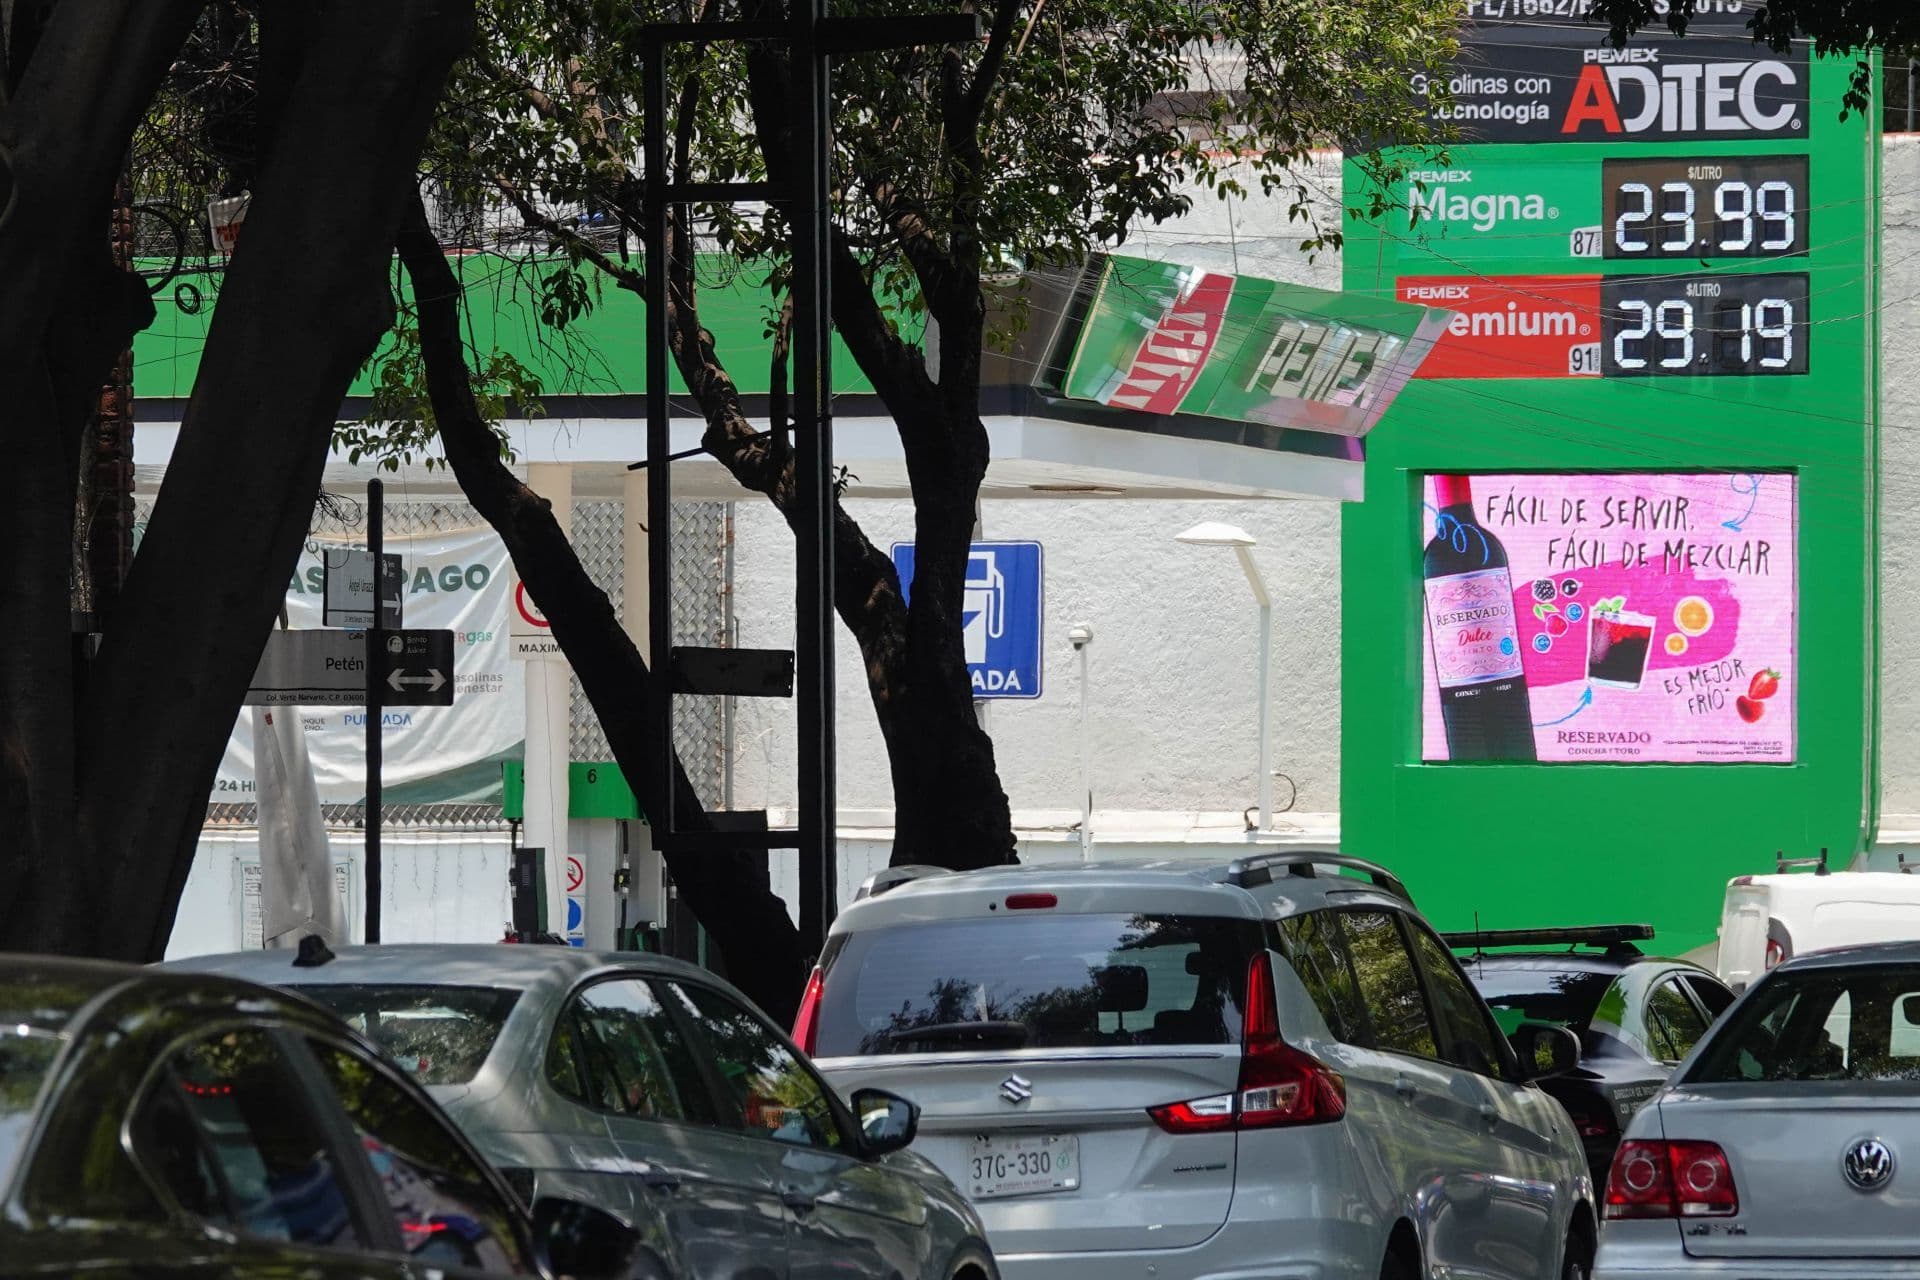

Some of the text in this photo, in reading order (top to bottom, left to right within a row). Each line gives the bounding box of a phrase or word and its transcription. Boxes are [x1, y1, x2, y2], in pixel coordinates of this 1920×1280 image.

[1583, 48, 1658, 63] PEMEX
[1409, 73, 1551, 95] Golinas con
[1408, 170, 1472, 183] PEMEX
[1687, 165, 1722, 180] $/LITRO
[1408, 186, 1545, 232] Magna
[1616, 181, 1795, 251] 23.99
[1573, 231, 1595, 255] 87
[1407, 286, 1470, 299] PEMEX
[1686, 282, 1721, 297] $/LITRO
[1446, 301, 1576, 336] emium
[1614, 298, 1793, 368] 29.19
[1572, 348, 1593, 371] 91
[1486, 487, 1548, 527] FÁCIL
[1561, 498, 1588, 524] DE
[1548, 529, 1771, 576] FÁCIL DE MEZCLAR
[1436, 605, 1508, 627] RESERVADO
[1458, 627, 1493, 646] Dulce
[518, 643, 561, 653] MAXIM
[325, 656, 364, 671] Petén
[455, 672, 504, 683] asolinas
[972, 669, 1022, 691] ADA
[1663, 658, 1746, 696] ES MEJOR
[456, 683, 504, 694] enestar
[344, 714, 412, 726] PUADA
[1557, 730, 1652, 744] RESERVADO
[1567, 747, 1607, 755] CONCHA
[1614, 747, 1641, 755] TORO
[219, 779, 238, 792] 24
[587, 768, 597, 785] 6
[972, 1151, 1051, 1180] 37G-330
